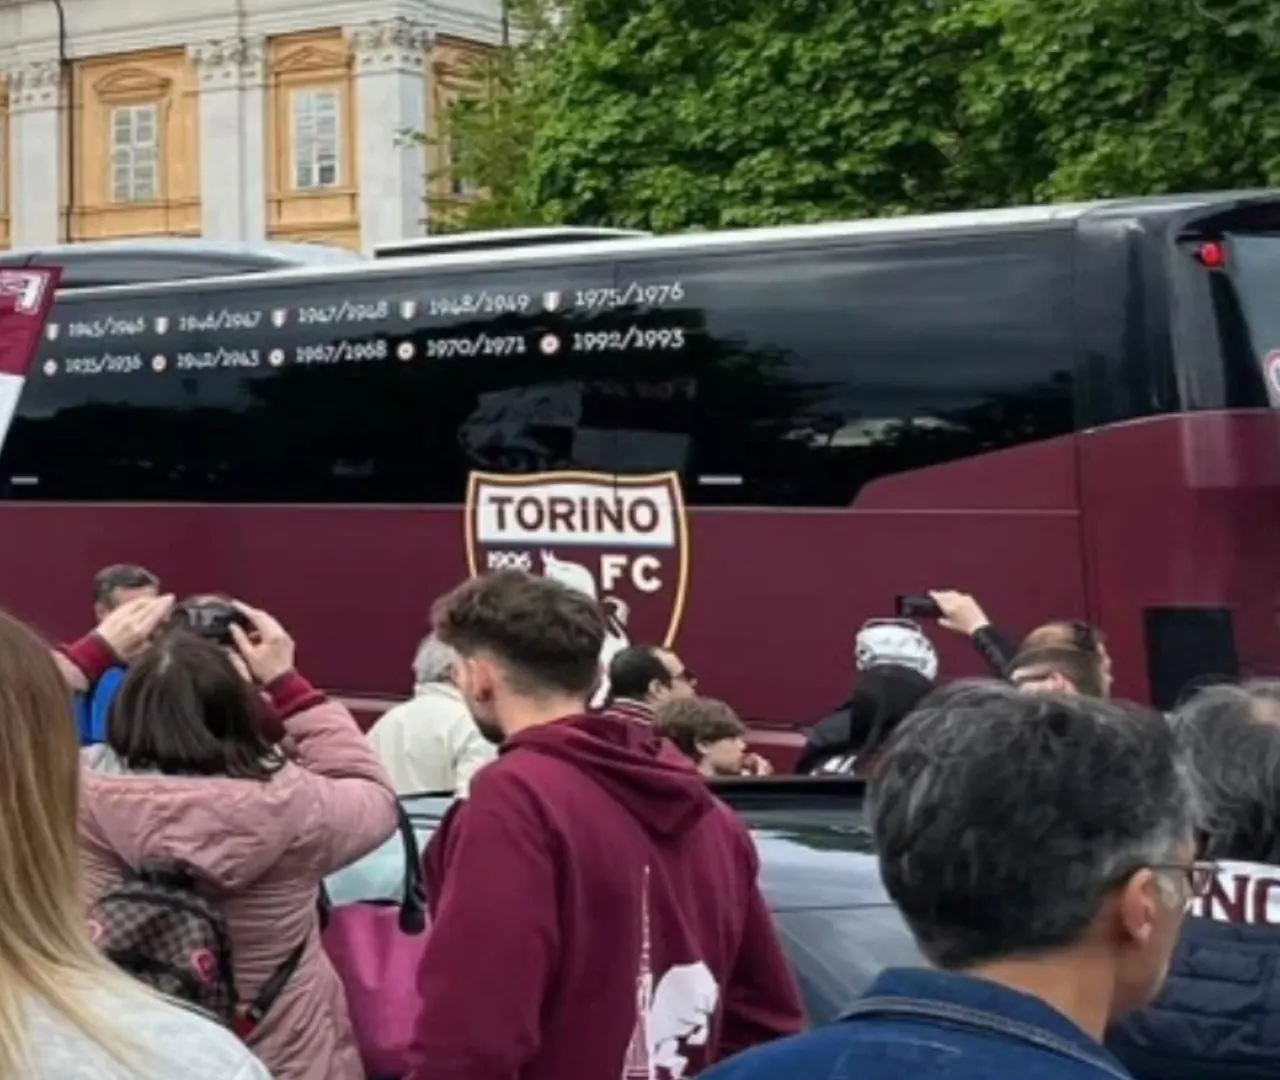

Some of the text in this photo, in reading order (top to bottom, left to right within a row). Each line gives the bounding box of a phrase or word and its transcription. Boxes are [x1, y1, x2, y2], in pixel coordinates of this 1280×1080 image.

[574, 282, 685, 307] 1975/1976
[426, 333, 527, 358] 1970/1971
[572, 325, 685, 351] 1992/1993
[488, 496, 660, 534] TORINO
[487, 550, 532, 570] 1906
[599, 554, 663, 592] FC
